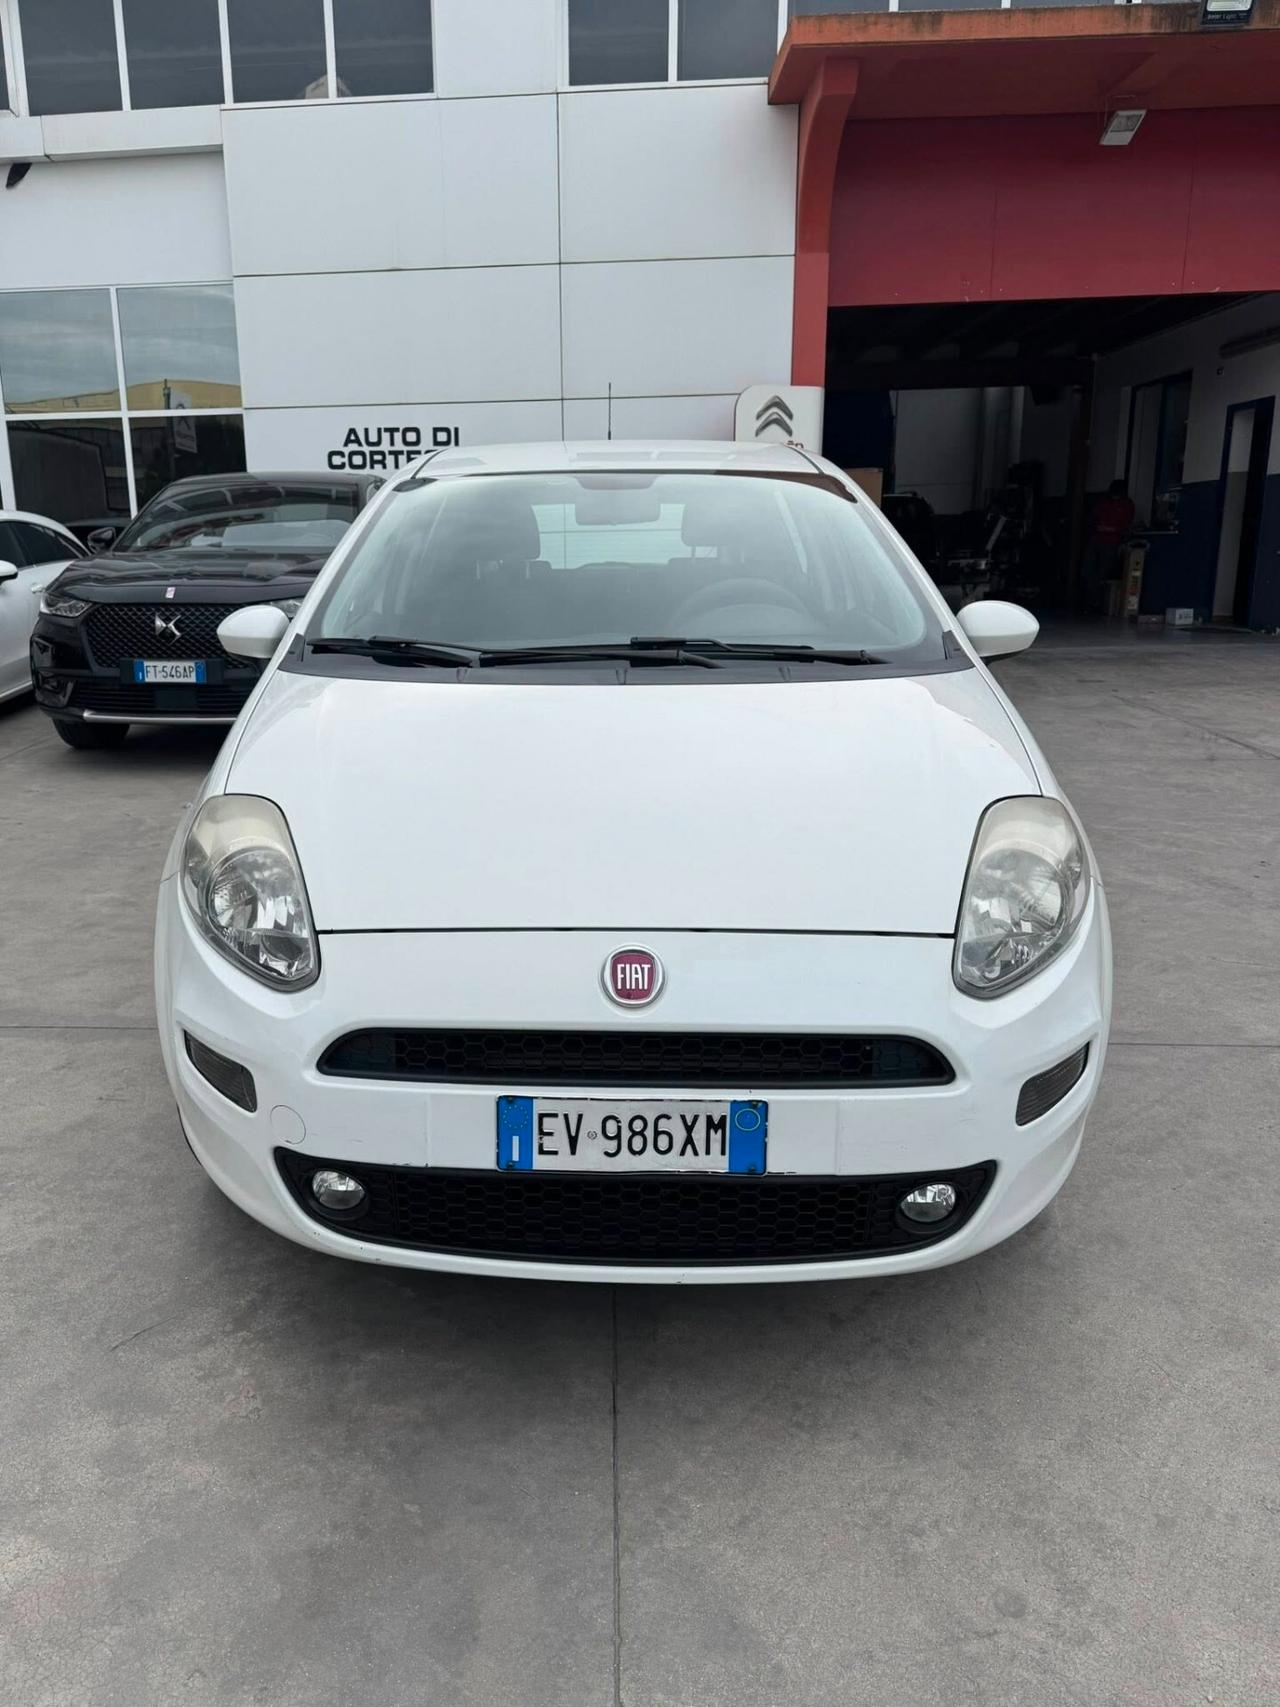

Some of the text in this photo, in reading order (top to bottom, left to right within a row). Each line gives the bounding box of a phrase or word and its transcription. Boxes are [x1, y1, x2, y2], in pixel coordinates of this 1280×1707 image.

[343, 427, 459, 447] AUTO DI
[327, 450, 436, 470] CORTE
[617, 963, 651, 990] FIAT
